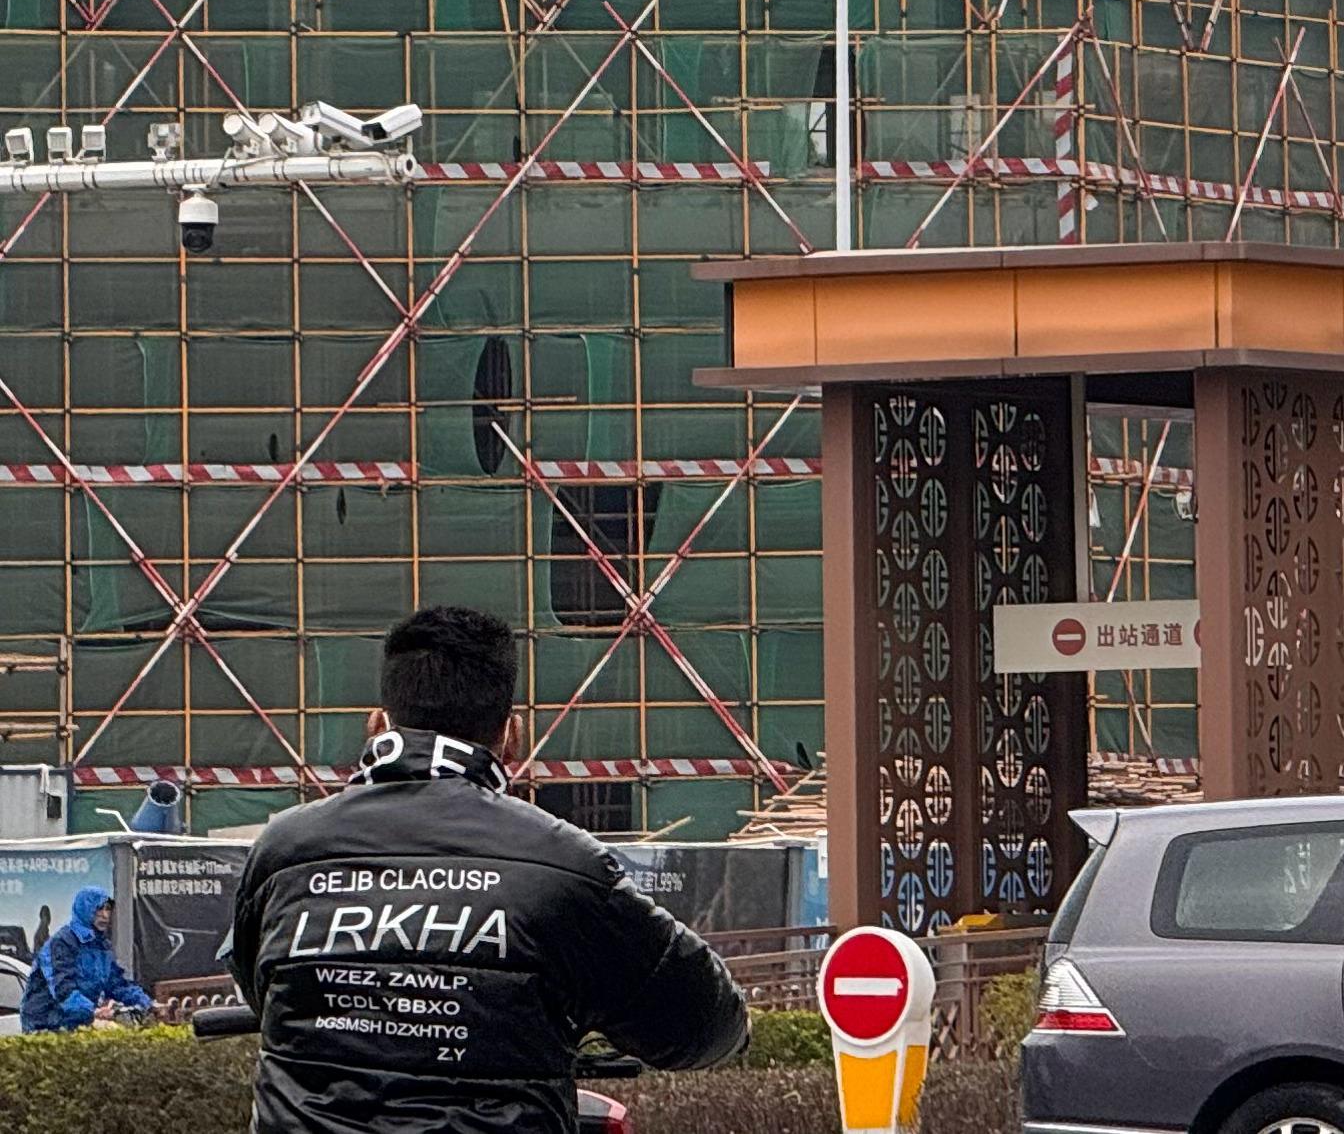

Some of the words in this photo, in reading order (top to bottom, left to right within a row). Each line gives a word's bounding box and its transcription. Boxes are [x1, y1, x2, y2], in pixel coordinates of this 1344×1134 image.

[1096, 623, 1183, 647] 出站通道
[289, 904, 508, 958] LRKHA
